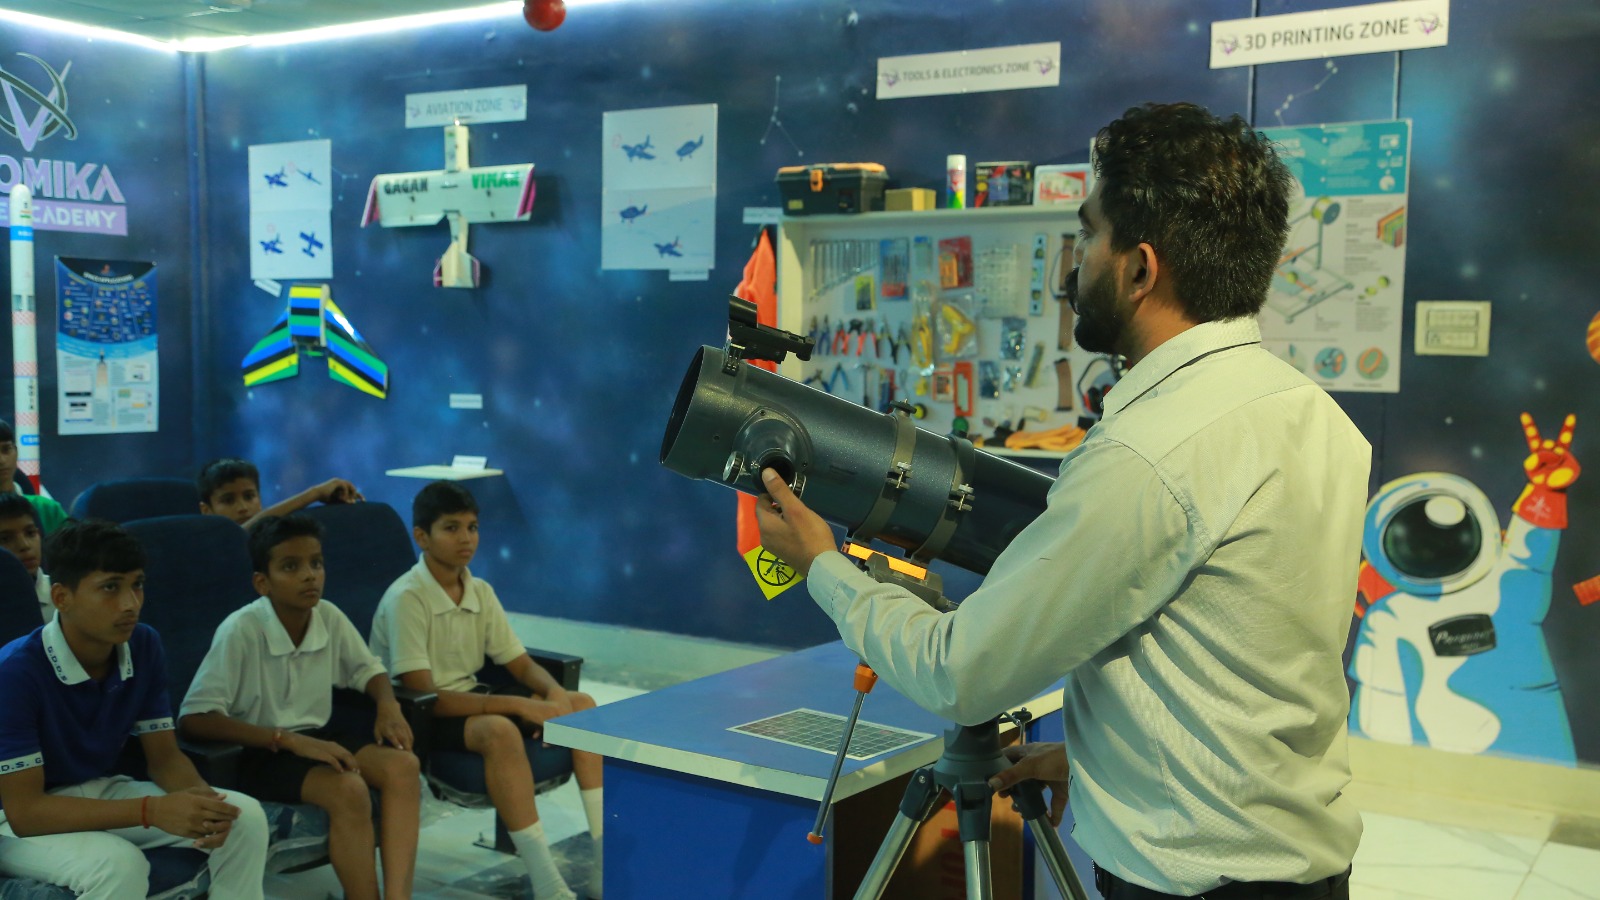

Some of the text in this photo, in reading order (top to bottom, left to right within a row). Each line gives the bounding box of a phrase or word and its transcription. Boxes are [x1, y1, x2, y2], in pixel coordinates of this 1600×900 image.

[1244, 18, 1410, 50] 3D PRINTING ZONE
[903, 61, 1030, 82] TOOLS & ELECTRONICS ZONE
[426, 98, 503, 116] AVIATION ZONE
[32, 205, 117, 229] CADEMY
